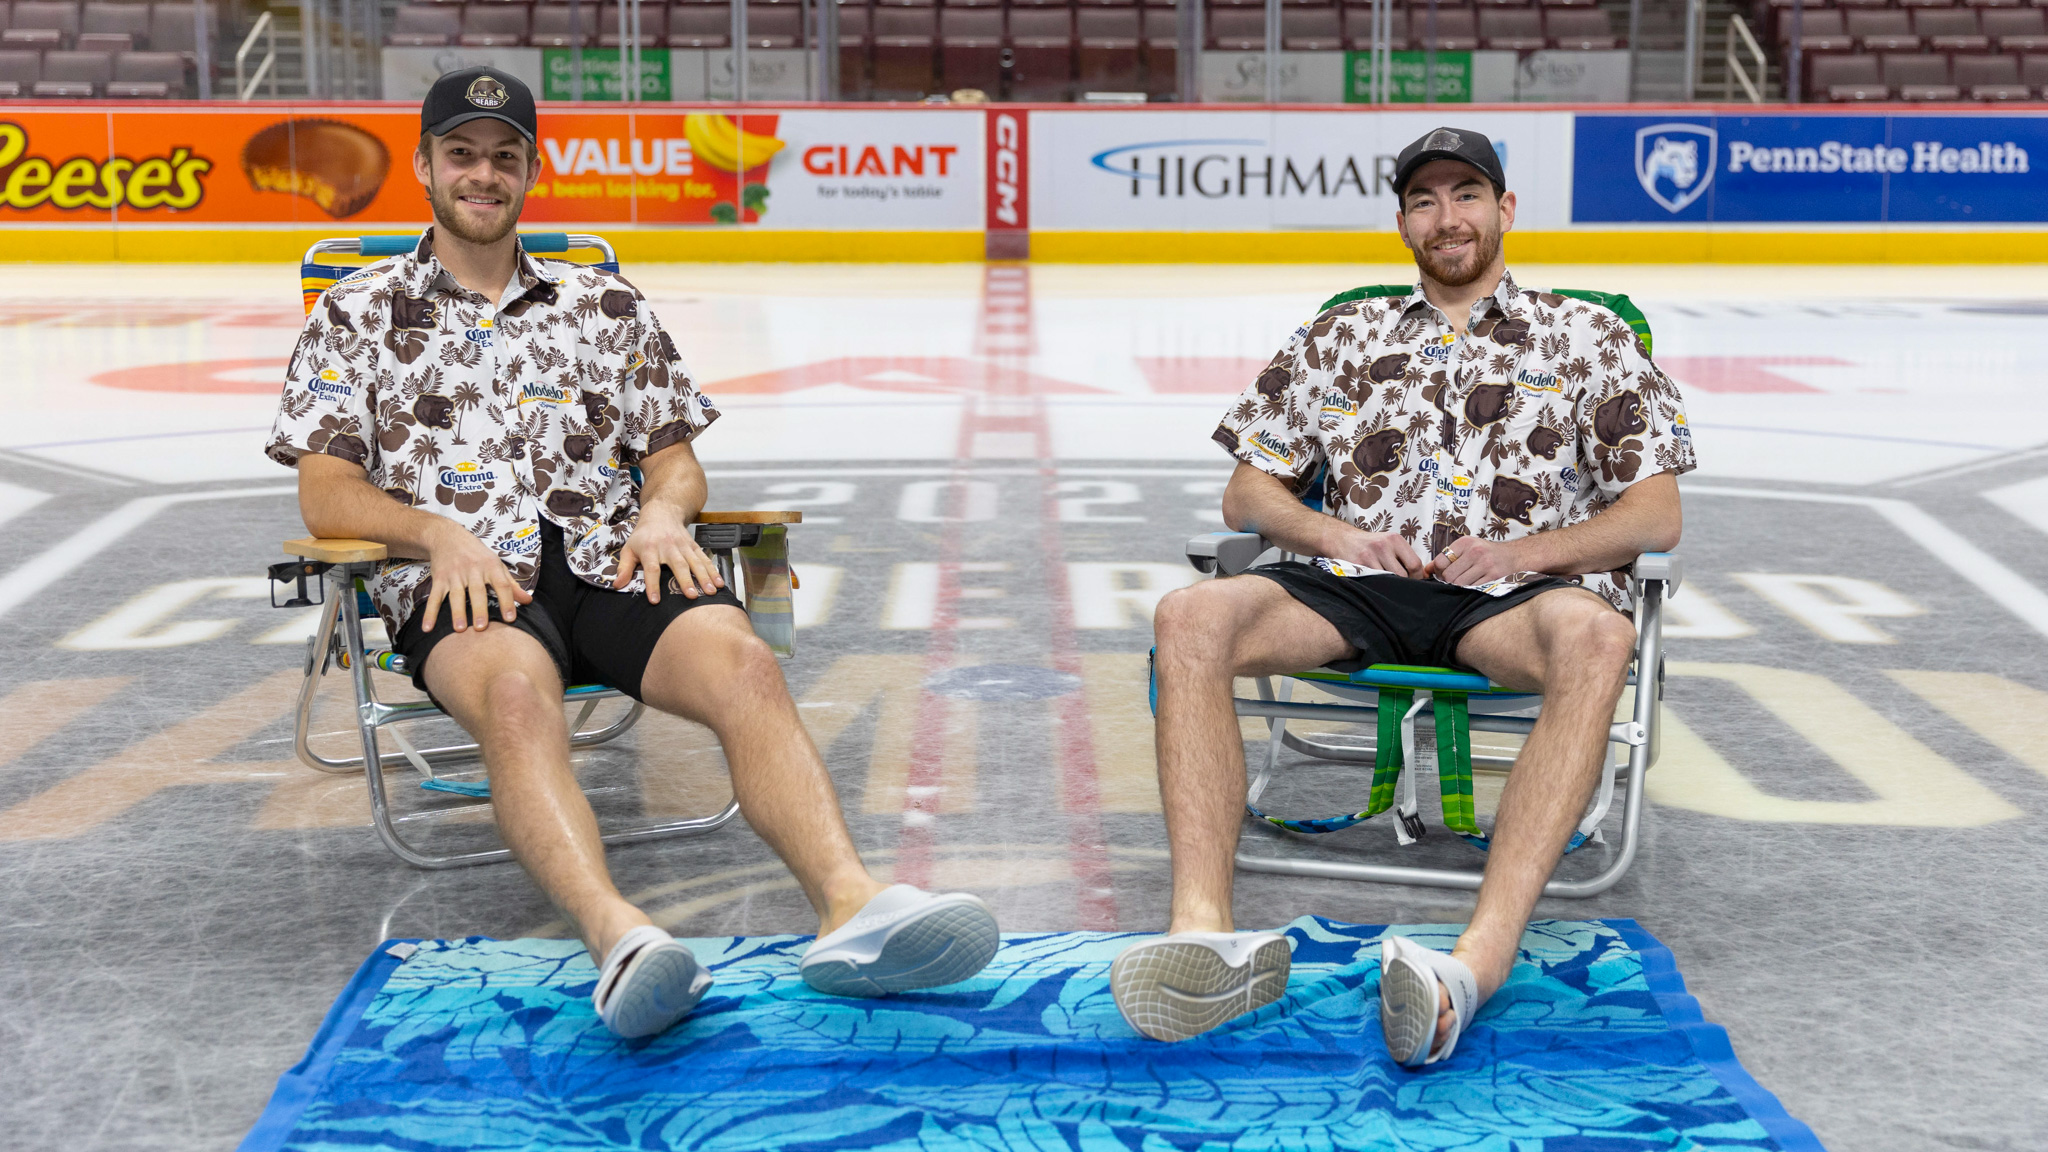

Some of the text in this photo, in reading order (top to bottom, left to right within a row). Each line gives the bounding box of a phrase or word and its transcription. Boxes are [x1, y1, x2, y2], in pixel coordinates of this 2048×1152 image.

[543, 138, 693, 176] VALUE
[803, 146, 958, 177] GIANT
[1727, 141, 2029, 173] PennState Health
[996, 113, 1018, 225] CCM
[1131, 154, 1398, 199] HIGHMAR
[552, 180, 602, 198] been
[606, 179, 680, 202] looking
[465, 329, 493, 343] Cor
[308, 377, 352, 396] Corona
[523, 382, 563, 400] Modelo
[1323, 392, 1352, 411] odelo
[1256, 429, 1291, 458] Modelo
[441, 471, 496, 487] Corona
[500, 530, 541, 552] Coron
